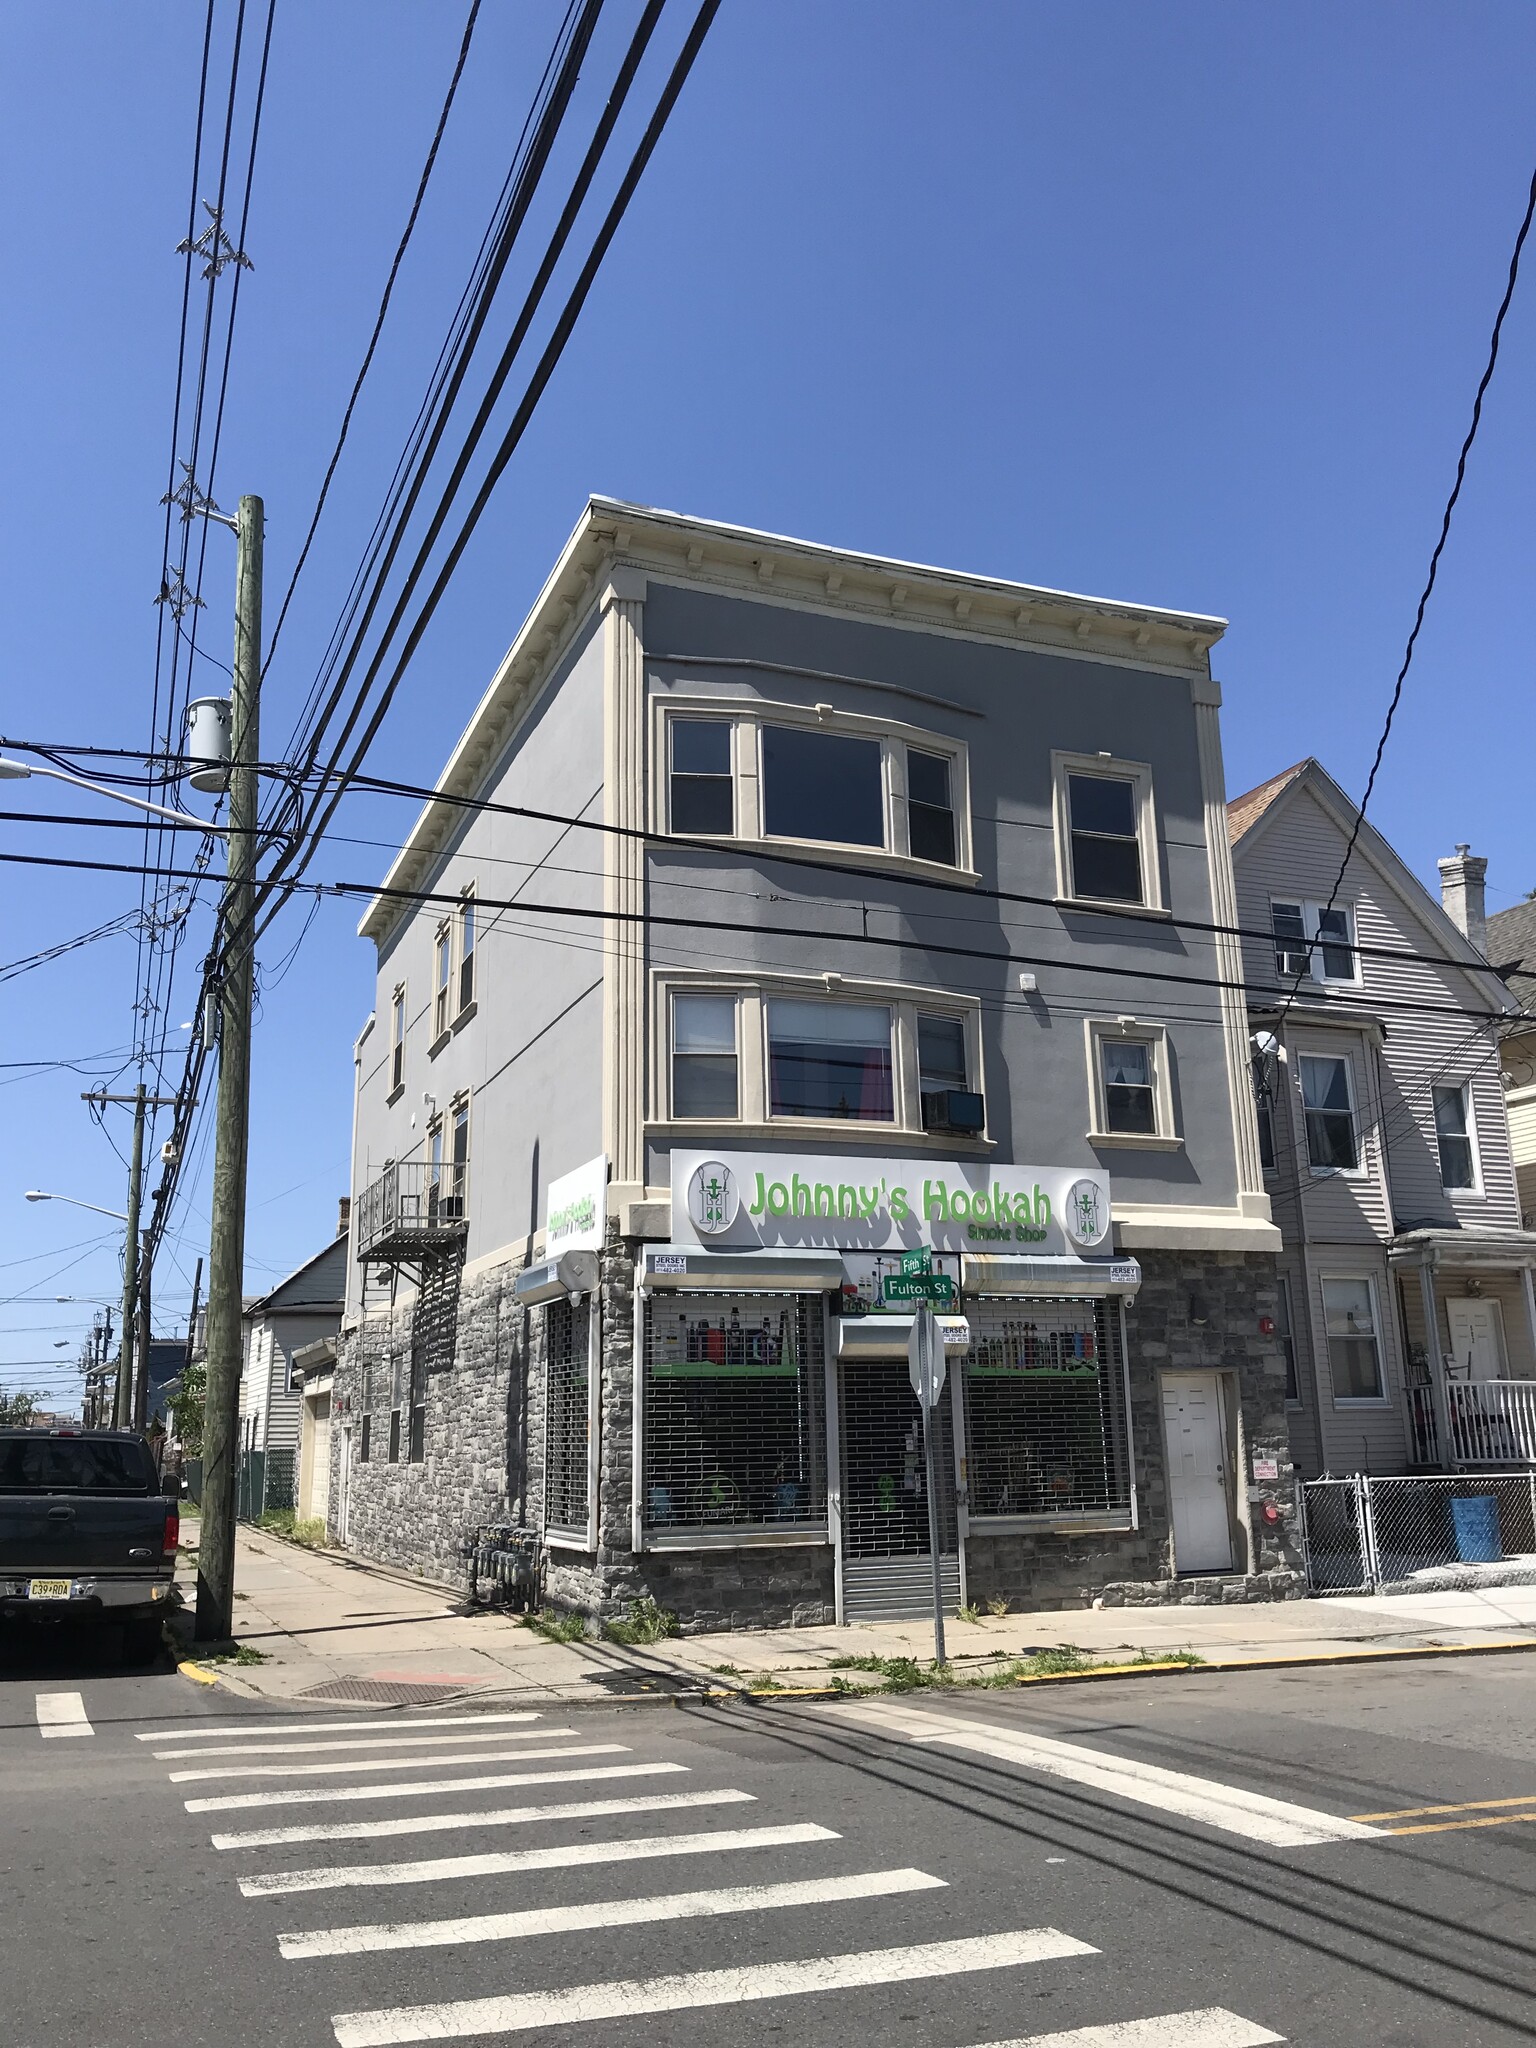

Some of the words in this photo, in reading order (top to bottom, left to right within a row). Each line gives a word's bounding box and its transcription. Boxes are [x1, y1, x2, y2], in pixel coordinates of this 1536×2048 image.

[749, 1172, 910, 1220] Johnny's
[921, 1179, 1051, 1225] Hookah
[967, 1224, 1011, 1241] Smoke
[1015, 1225, 1047, 1242] Shop
[655, 1256, 686, 1264] JERSEY
[903, 1258, 920, 1273] Fifth
[923, 1254, 930, 1266] St
[889, 1280, 931, 1295] Fulton
[934, 1282, 947, 1294] St
[942, 1326, 967, 1334] JERSEY
